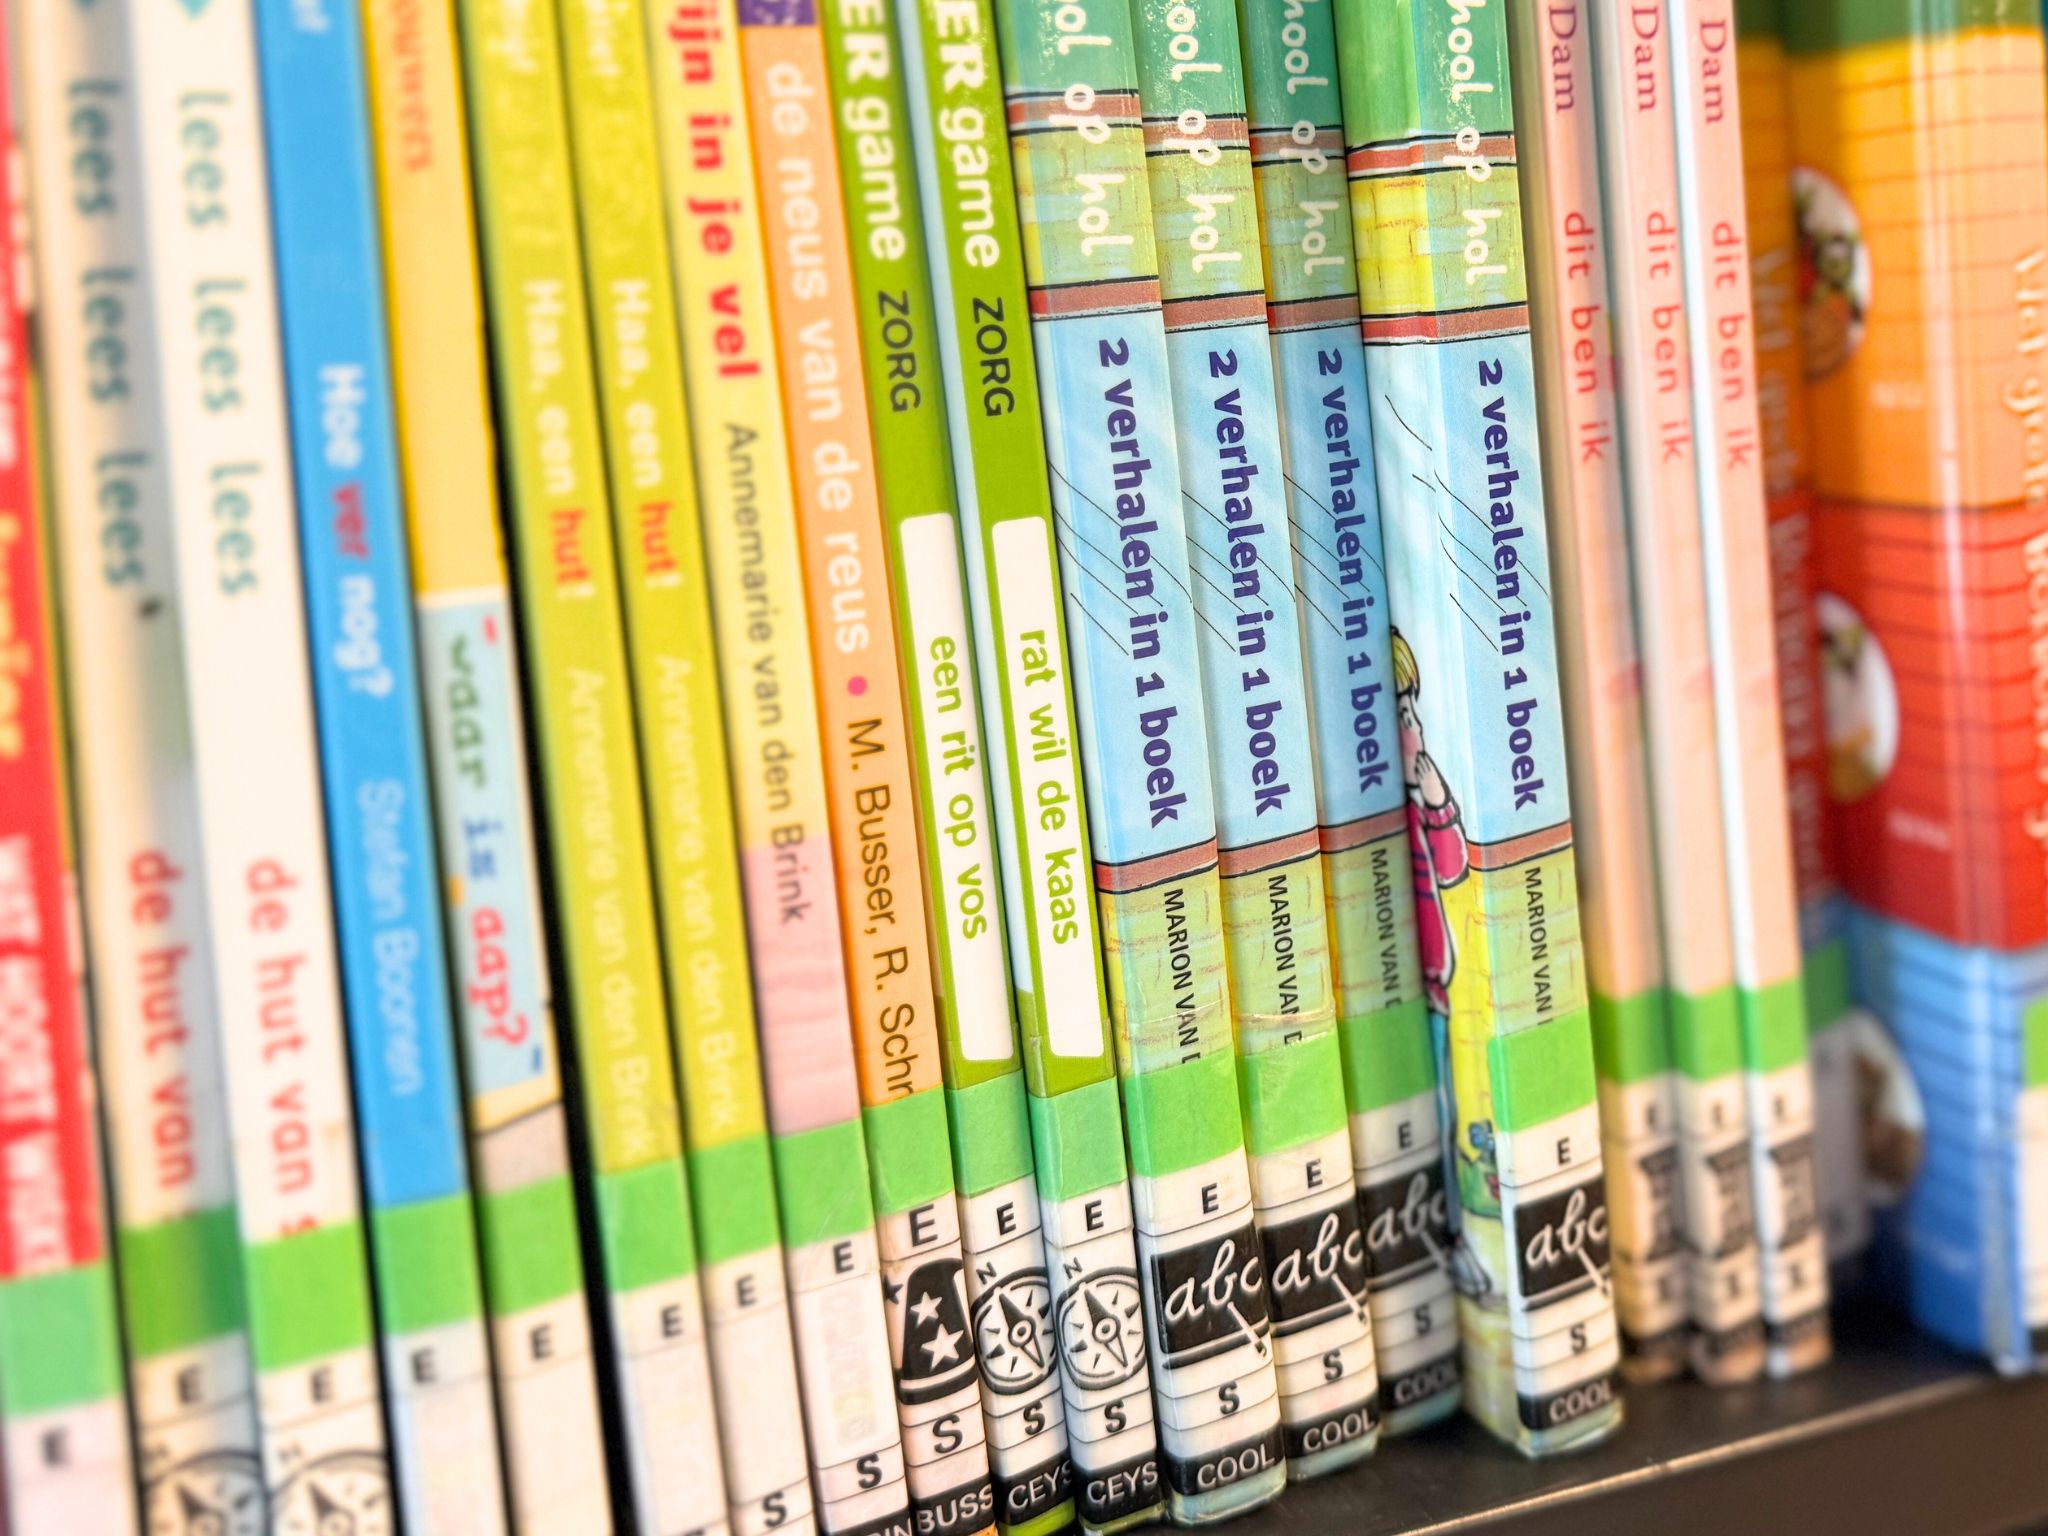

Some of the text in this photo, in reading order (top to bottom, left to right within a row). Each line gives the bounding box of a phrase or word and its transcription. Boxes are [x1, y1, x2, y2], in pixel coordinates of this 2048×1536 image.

[1548, 4, 1578, 114] Dam
[1631, 5, 1659, 113] Dam
[1700, 19, 1726, 125] Dam
[840, 0, 906, 262] ER game
[935, 0, 1000, 269] ER game
[1048, 0, 1134, 257] ol op hol
[1163, 0, 1243, 274] ool op hol
[1280, 120, 1328, 175] op
[1443, 126, 1492, 183] op
[668, 0, 760, 378] ijn in je vel
[1300, 200, 1346, 277] hol
[1462, 208, 1508, 285] hol
[67, 79, 150, 587] lees lees lees
[178, 92, 262, 597] lees lees lees
[766, 62, 869, 654] de neus van de reus
[878, 289, 921, 413] ZORG
[972, 296, 1015, 415] ZORG
[1564, 210, 1611, 465] dit ben ik
[1646, 210, 1692, 464] dit ben ik
[1712, 221, 1755, 471] dit ben ik
[535, 406, 576, 495] een
[625, 402, 663, 488] een
[1098, 337, 1189, 829] 2 verhalen in 1 boek
[1208, 349, 1290, 817] 2 verhalen in 1 boek
[1317, 347, 1391, 794] 2 verhalen in 1 boek
[1478, 358, 1545, 811] 2 verhalen in 1 boek
[725, 422, 811, 925] Annemarie van den Brink
[848, 717, 886, 772] M.
[930, 635, 987, 940] een rit op vos
[1020, 629, 1078, 945] rat wil de kaas
[244, 858, 301, 932] de
[855, 783, 896, 936] Busser,
[1370, 848, 1396, 943] MARION
[1163, 887, 1194, 990] MARION
[1268, 874, 1296, 973] MARION
[1524, 867, 1549, 962] MARION
[256, 953, 307, 1061] hut
[873, 946, 908, 991] R.
[1380, 943, 1400, 994] VAN
[1530, 963, 1552, 1013] VAN
[127, 849, 196, 1190] de hut van
[1174, 991, 1200, 1047] VAN
[268, 1083, 313, 1195] van
[1306, 1159, 1323, 1188] E
[1399, 1122, 1412, 1148] E
[1557, 1138, 1572, 1165] E
[908, 1204, 939, 1247] E
[996, 1202, 1016, 1235] E
[1085, 1199, 1104, 1232] E
[1201, 1182, 1219, 1215] E
[1525, 1188, 1608, 1268] abc
[735, 1275, 756, 1309] E
[833, 1241, 854, 1275] E
[1164, 1239, 1262, 1323] abc
[1272, 1213, 1363, 1293] abc
[529, 1323, 553, 1360] E
[661, 1304, 683, 1338] E
[1415, 1305, 1432, 1335] S
[1570, 1323, 1588, 1353] S
[411, 1345, 436, 1383] E
[1218, 1381, 1241, 1415] S
[1323, 1349, 1344, 1380] S
[933, 1413, 964, 1454] S
[1023, 1400, 1046, 1435] S
[1104, 1400, 1126, 1433] S
[1302, 1407, 1375, 1452] COOL
[857, 1453, 883, 1489] S
[1086, 1461, 1158, 1505] CEYS
[1197, 1443, 1275, 1489] COOL
[762, 1492, 788, 1528] S
[917, 1486, 993, 1533] BUSS
